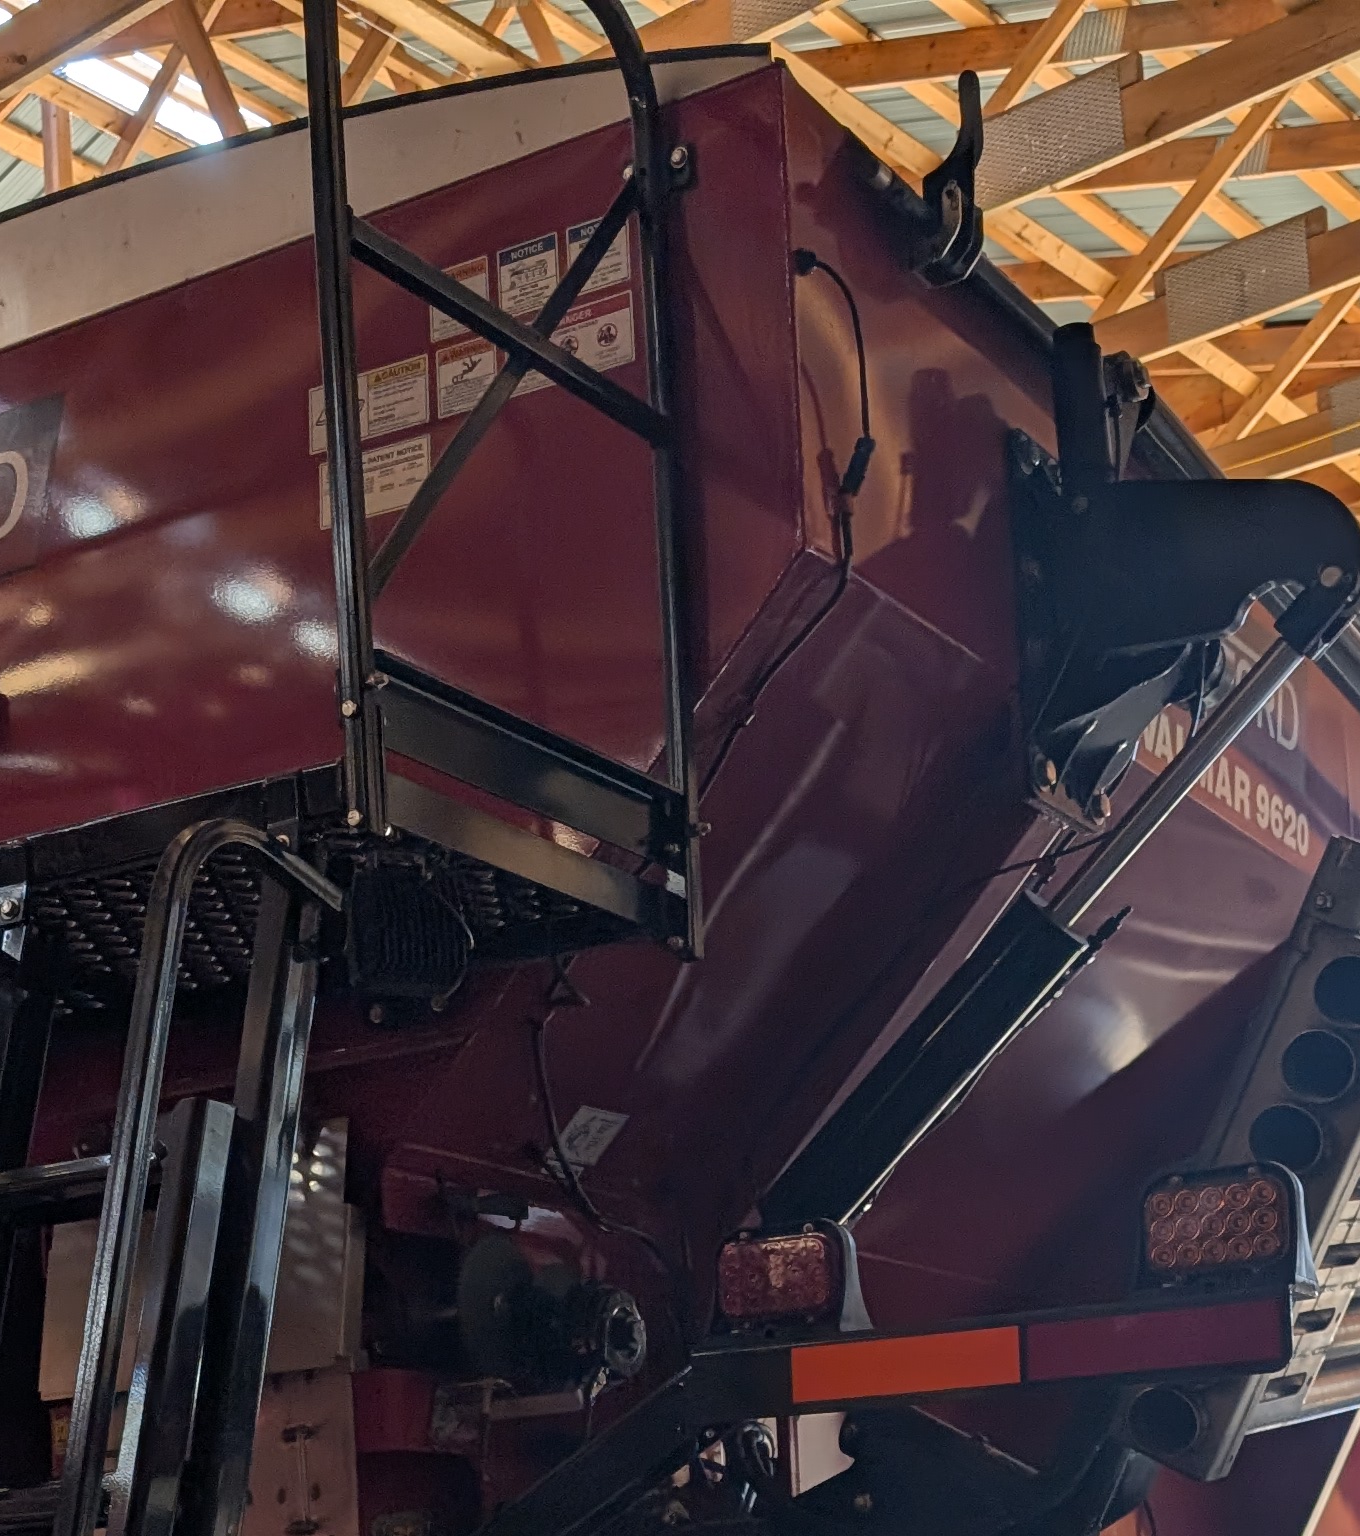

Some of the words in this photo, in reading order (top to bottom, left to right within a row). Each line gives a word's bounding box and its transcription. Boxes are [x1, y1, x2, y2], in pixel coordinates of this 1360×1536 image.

[511, 242, 544, 261] NOTICE
[561, 308, 593, 325] NGER
[381, 362, 421, 381] CAUTION
[397, 443, 423, 457] NOTICE
[1143, 714, 1252, 820] VAAR
[1255, 782, 1310, 857] 9620
